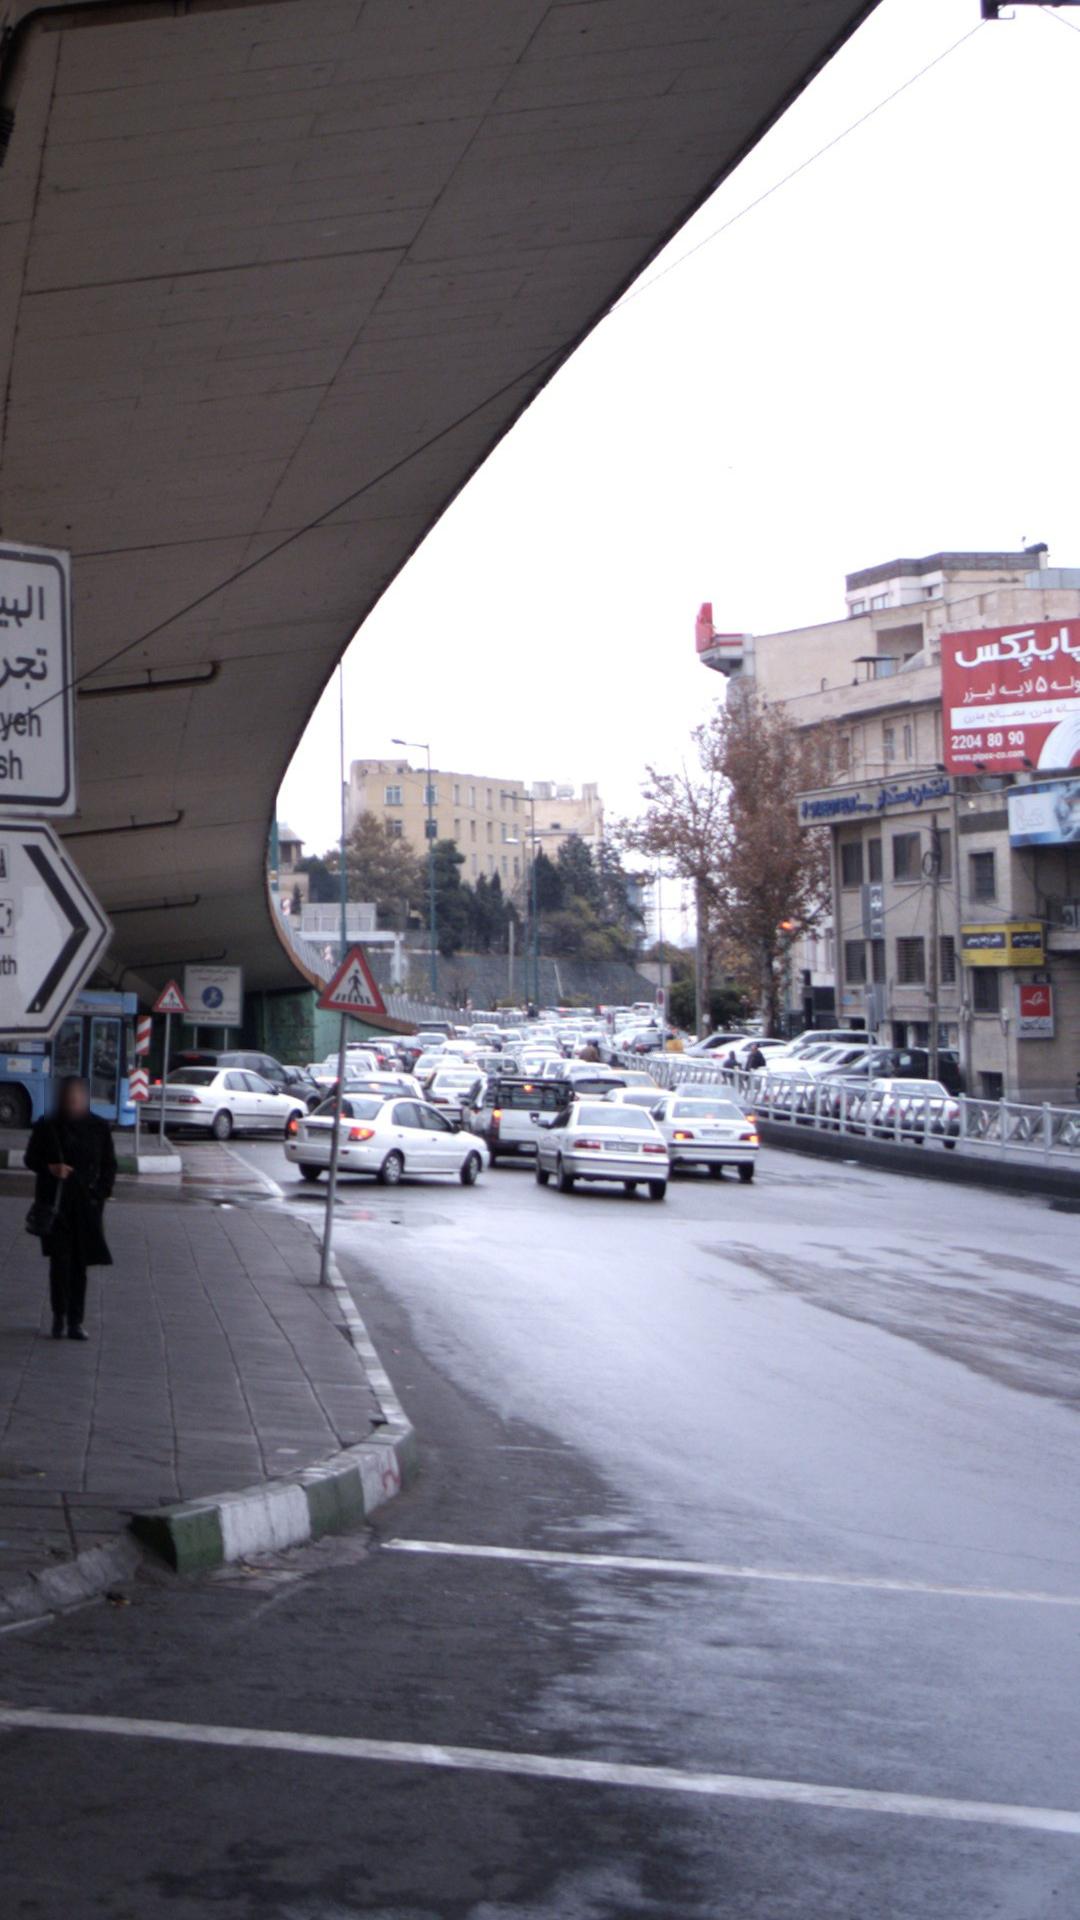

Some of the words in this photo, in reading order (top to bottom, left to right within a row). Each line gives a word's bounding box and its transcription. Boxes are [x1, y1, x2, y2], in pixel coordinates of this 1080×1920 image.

[998, 679, 1033, 697] لایه
[951, 734, 982, 749] 2204
[987, 732, 1003, 748] 80
[1008, 731, 1025, 745] 90
